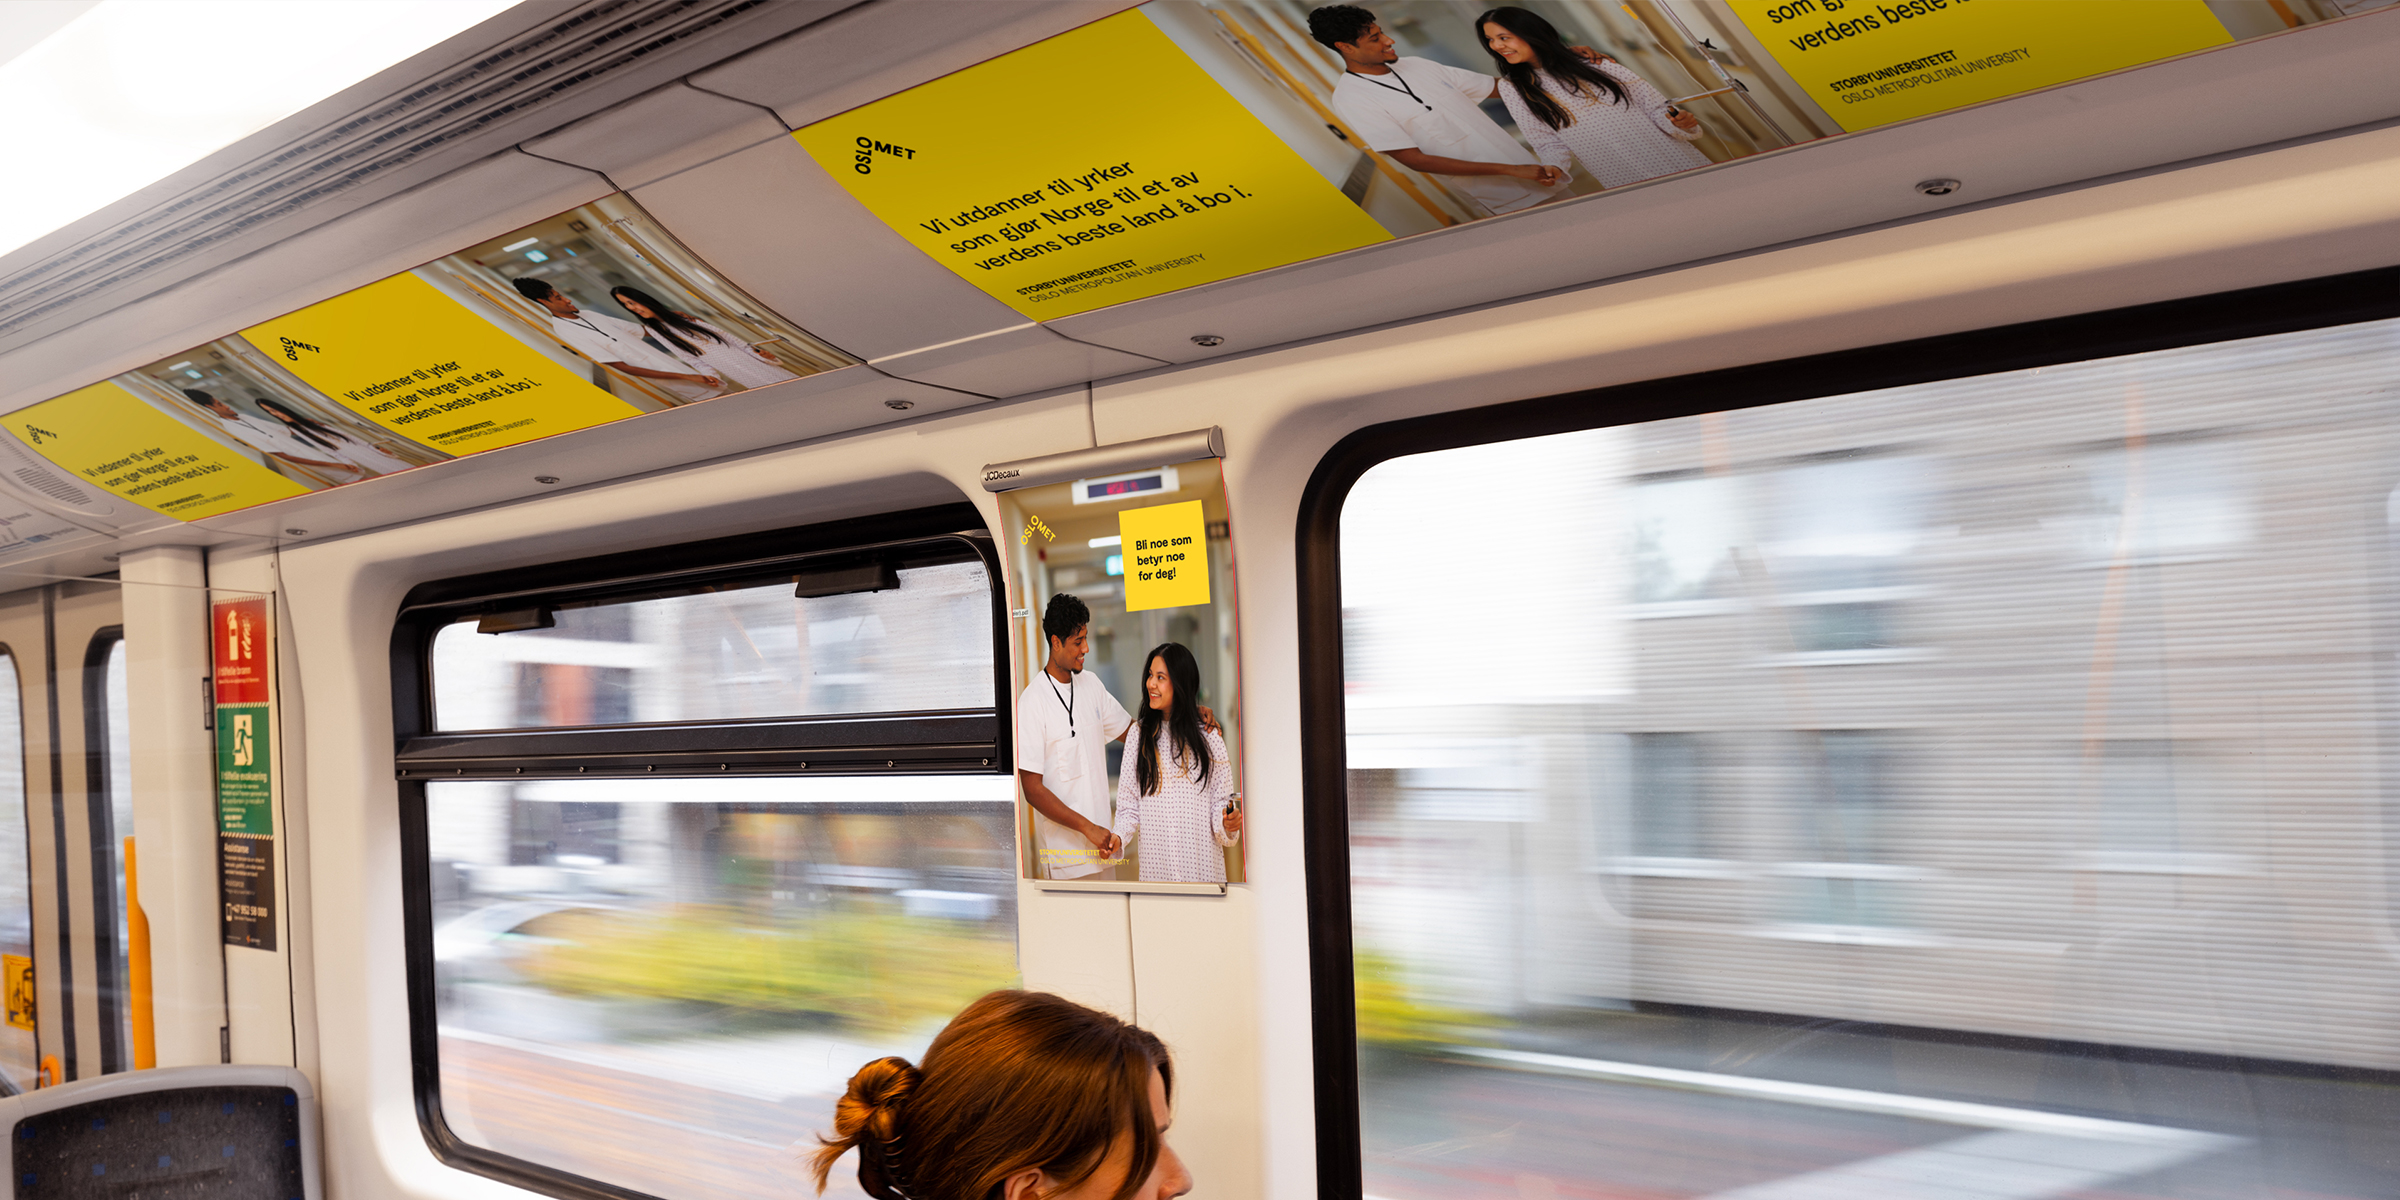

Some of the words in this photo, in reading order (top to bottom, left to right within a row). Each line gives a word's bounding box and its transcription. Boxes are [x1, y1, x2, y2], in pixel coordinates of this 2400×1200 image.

[1767, 0, 1816, 24] som
[1789, 14, 1881, 51] verdens
[1876, 0, 1948, 24] beste
[1829, 50, 1958, 93] STORBYUNIVERSITETET
[1841, 89, 1876, 105] OSLO
[1875, 64, 1963, 96] METROPOLITAN
[1961, 47, 2031, 75] UNIVERSITY
[919, 217, 950, 235] Vi
[948, 188, 1046, 228] utdanner
[1047, 177, 1076, 197] til
[1073, 160, 1135, 192] yrker
[950, 231, 999, 254] som
[998, 217, 1042, 243] gjør
[1040, 197, 1114, 226] Norge
[1113, 186, 1141, 205] til
[1142, 179, 1170, 196] et
[1170, 169, 1201, 189] av
[974, 238, 1063, 272] verdens
[1057, 221, 1127, 248] beste
[1121, 203, 1179, 230] land
[1176, 198, 1200, 215] å
[1192, 189, 1232, 210] bo
[1228, 183, 1253, 199] i.
[1016, 259, 1138, 296] STORBYUNIVERSITETET
[1028, 290, 1060, 303] OSLO
[1059, 269, 1143, 295] METROPOLITAN
[1142, 253, 1206, 275] UNIVERSITY
[343, 390, 362, 402] Vi
[361, 375, 415, 397] utdanner
[412, 369, 431, 381] til
[426, 360, 462, 379] yrker
[369, 400, 399, 414] som
[396, 392, 421, 409] gjør
[416, 381, 458, 398] Norge
[455, 375, 475, 387] til
[471, 372, 487, 384] et
[486, 368, 505, 379] av
[497, 384, 515, 395] å
[505, 380, 531, 392] bo
[434, 396, 476, 412] beste
[468, 387, 503, 403] land
[390, 405, 442, 425] verdens
[984, 468, 1021, 482] JCDecaux
[1136, 539, 1147, 551] Bli
[1150, 539, 1168, 549] noe
[1171, 536, 1192, 546] som
[1137, 555, 1163, 567] betyr
[1166, 552, 1185, 562] noe
[1138, 570, 1153, 581] for
[1155, 567, 1176, 580] deg!
[1039, 849, 1100, 857] STORBYUNIVERSITETET
